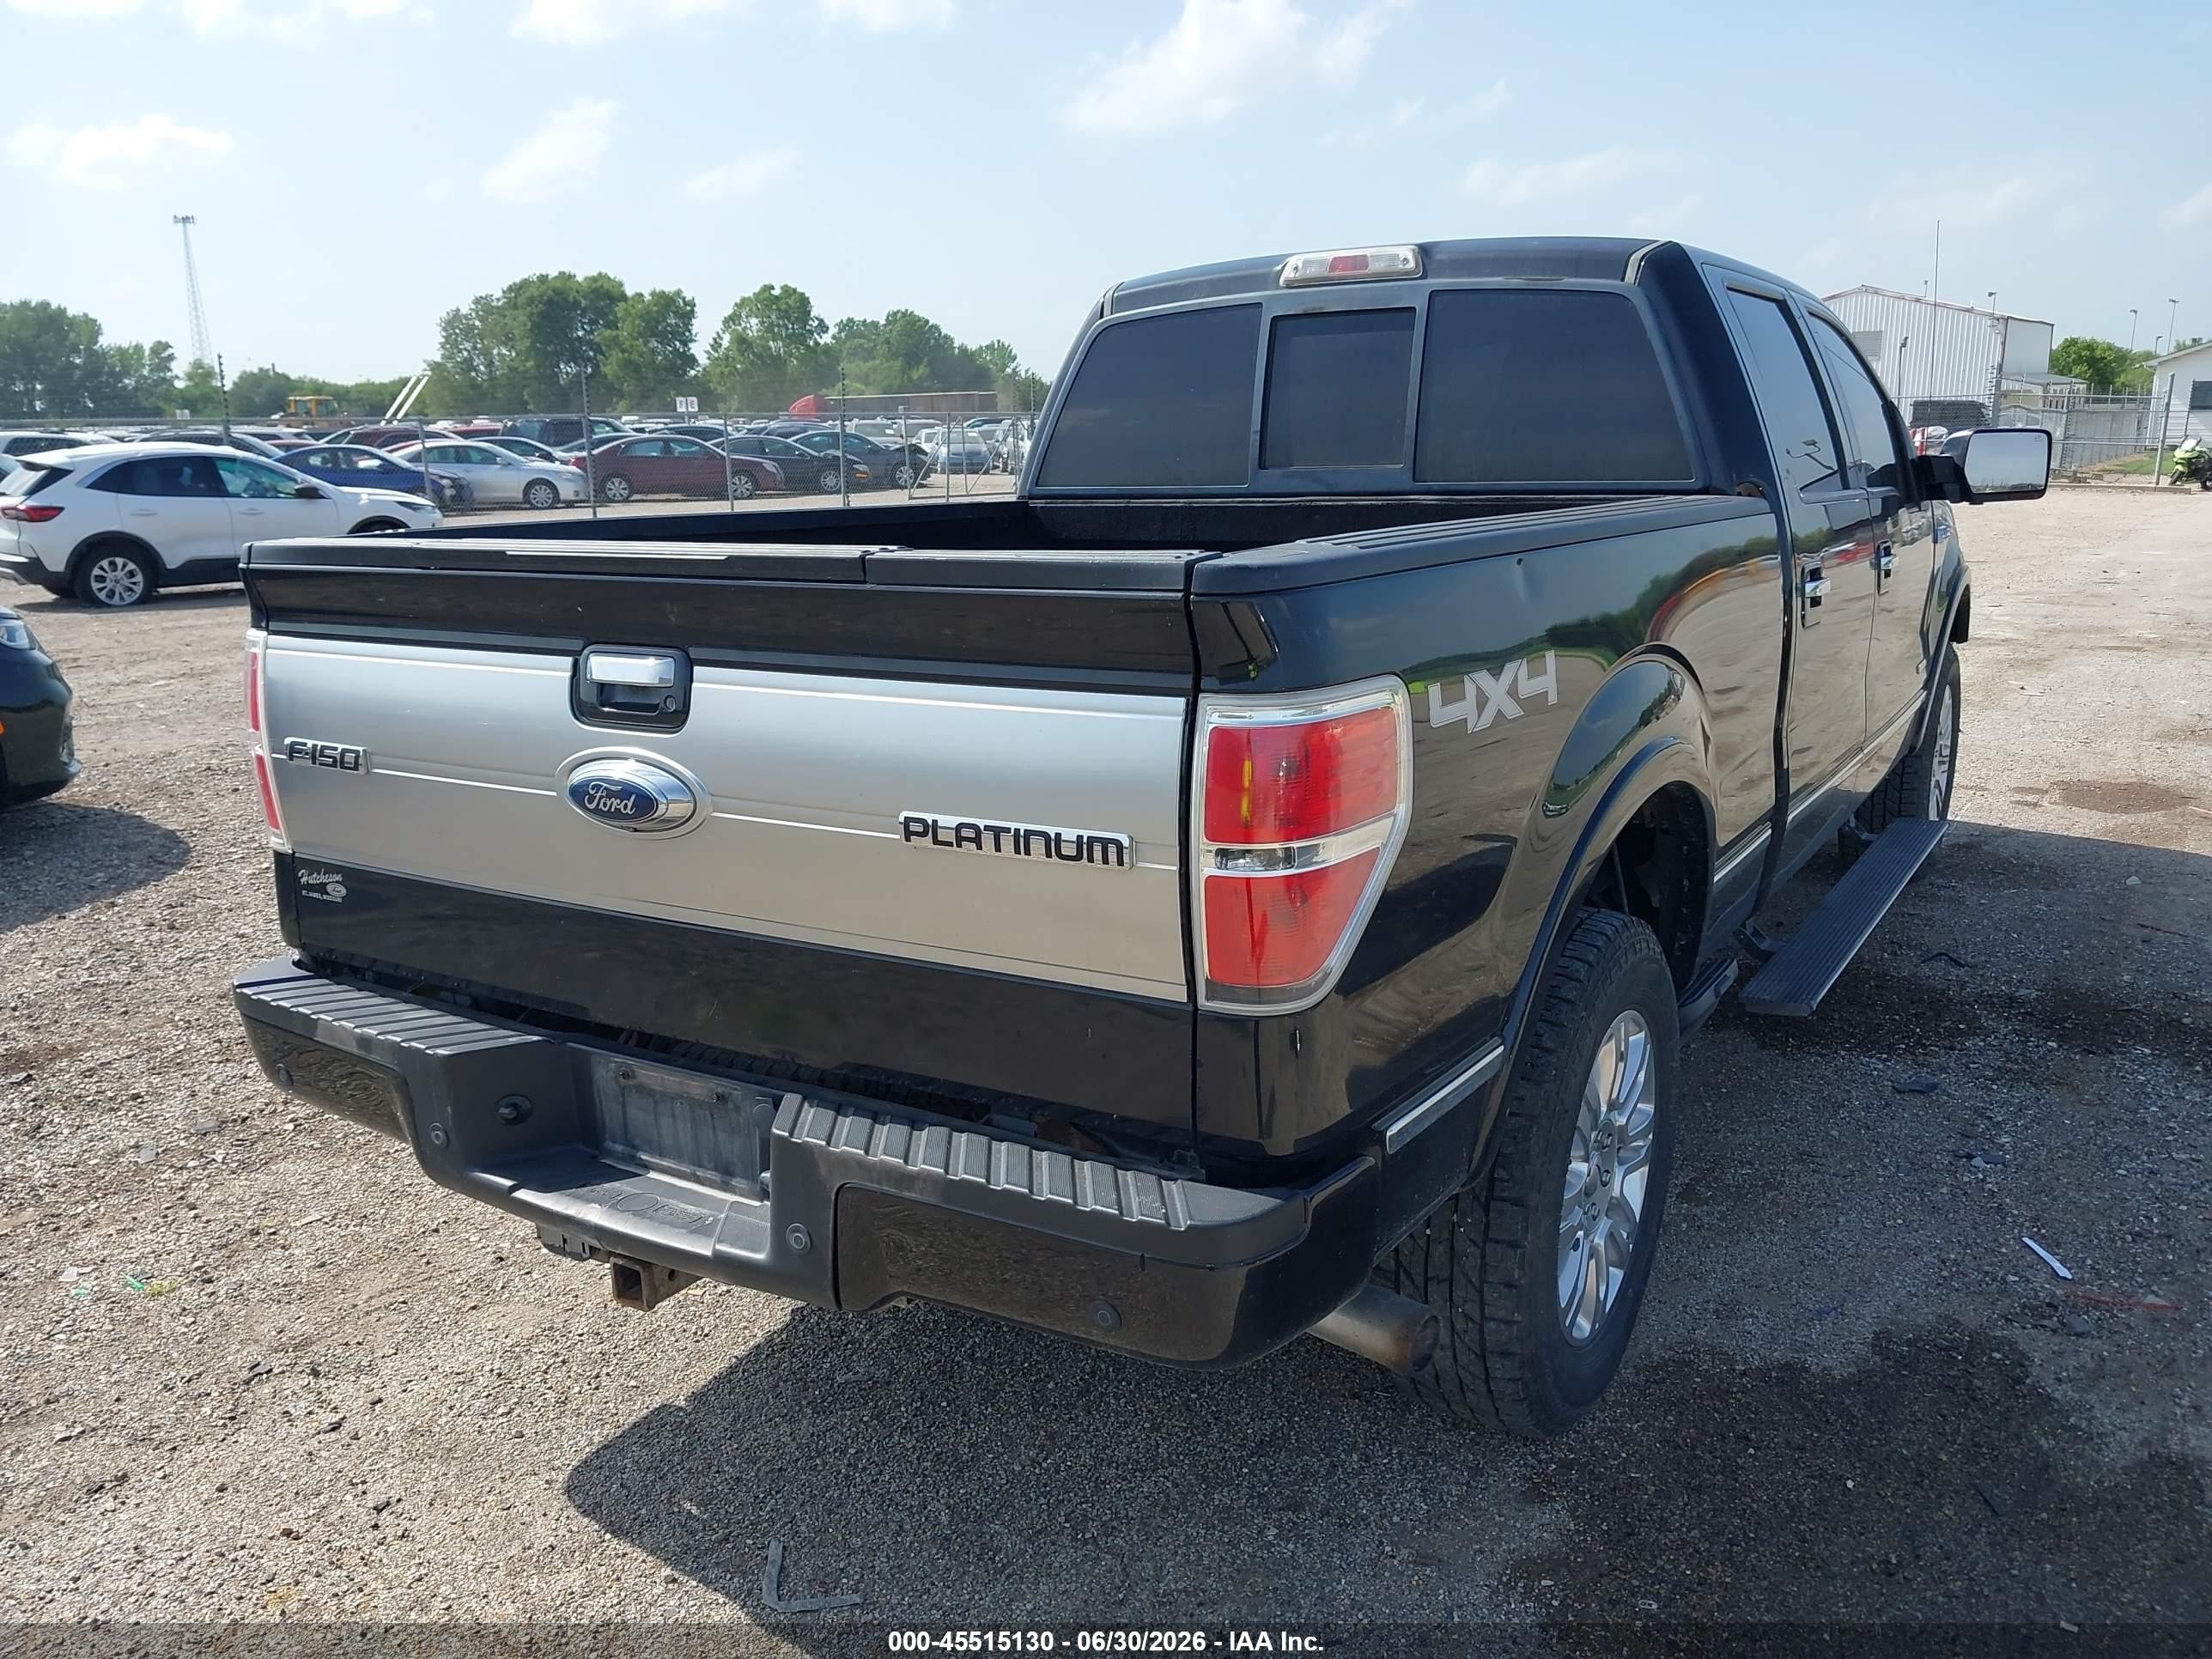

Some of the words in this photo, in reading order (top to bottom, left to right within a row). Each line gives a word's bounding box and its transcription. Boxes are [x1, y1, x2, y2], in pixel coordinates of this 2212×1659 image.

[288, 740, 361, 772] F-150
[584, 781, 636, 815] Ford
[903, 815, 1125, 867] PLATINUM
[298, 867, 343, 885] Hutcheson
